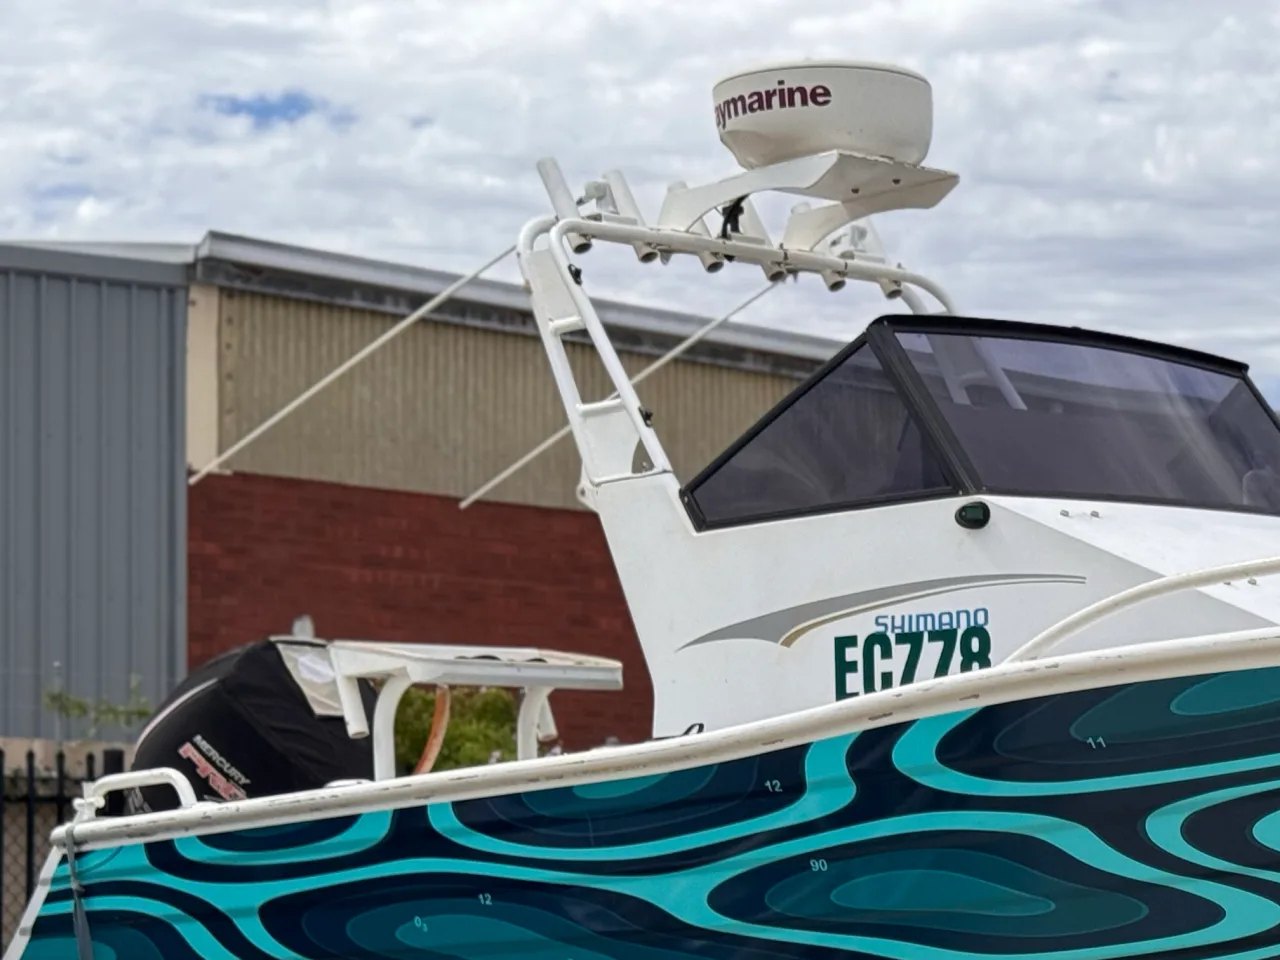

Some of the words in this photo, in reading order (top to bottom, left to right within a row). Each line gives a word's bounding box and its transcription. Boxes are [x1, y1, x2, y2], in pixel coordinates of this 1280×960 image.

[874, 607, 989, 634] SHIMANO
[834, 626, 992, 701] EC778
[763, 778, 784, 793] 12
[809, 858, 829, 873] 90
[477, 892, 494, 907] 12
